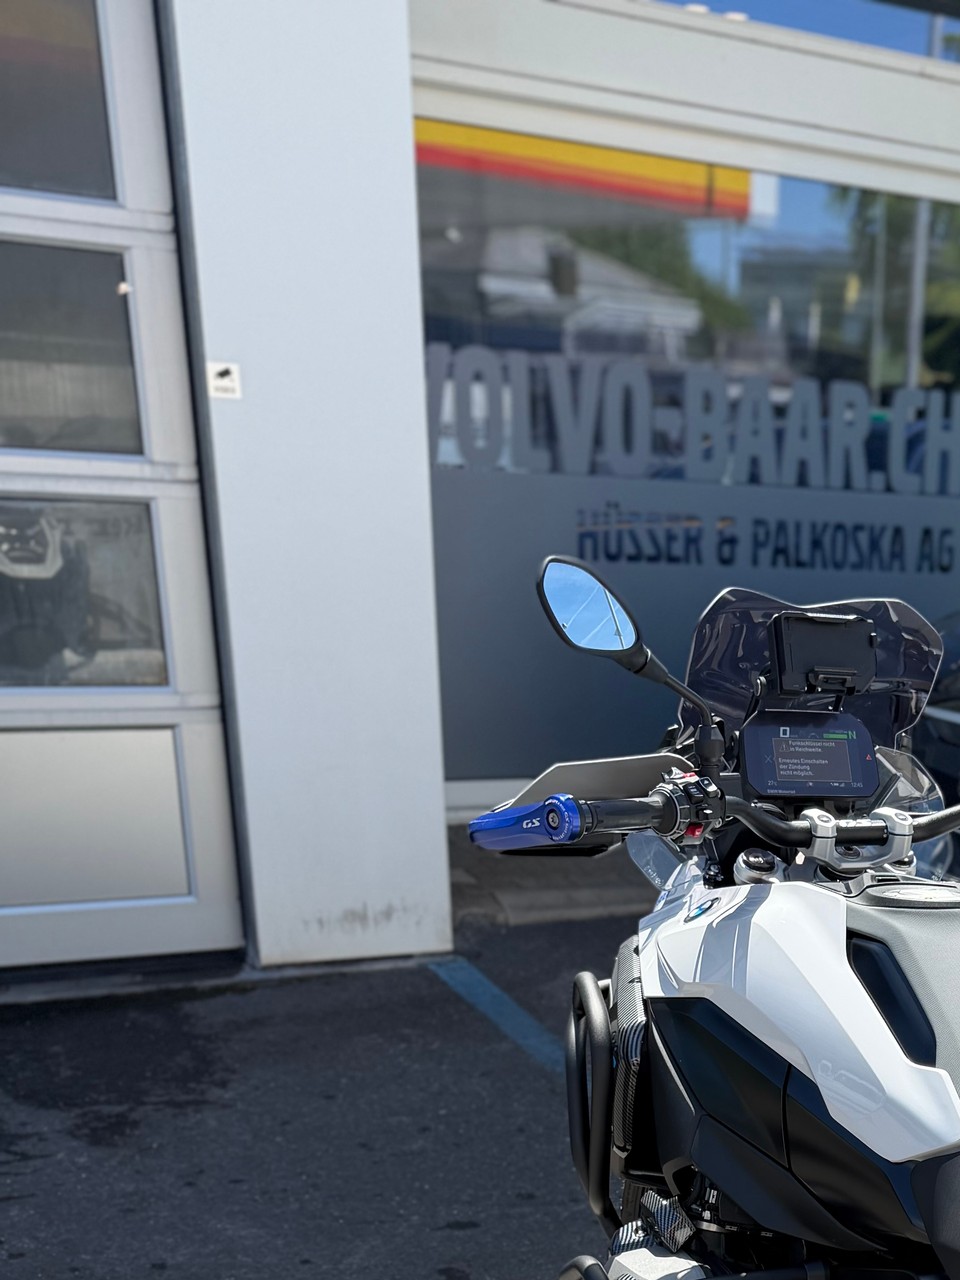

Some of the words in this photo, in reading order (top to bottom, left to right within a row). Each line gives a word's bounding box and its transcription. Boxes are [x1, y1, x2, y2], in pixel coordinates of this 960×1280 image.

[577, 502, 704, 565] HÜSSER
[715, 516, 740, 567] &
[751, 517, 907, 573] PALKOSKA
[915, 527, 955, 574] AG
[848, 730, 857, 739] N
[522, 818, 541, 829] GS
